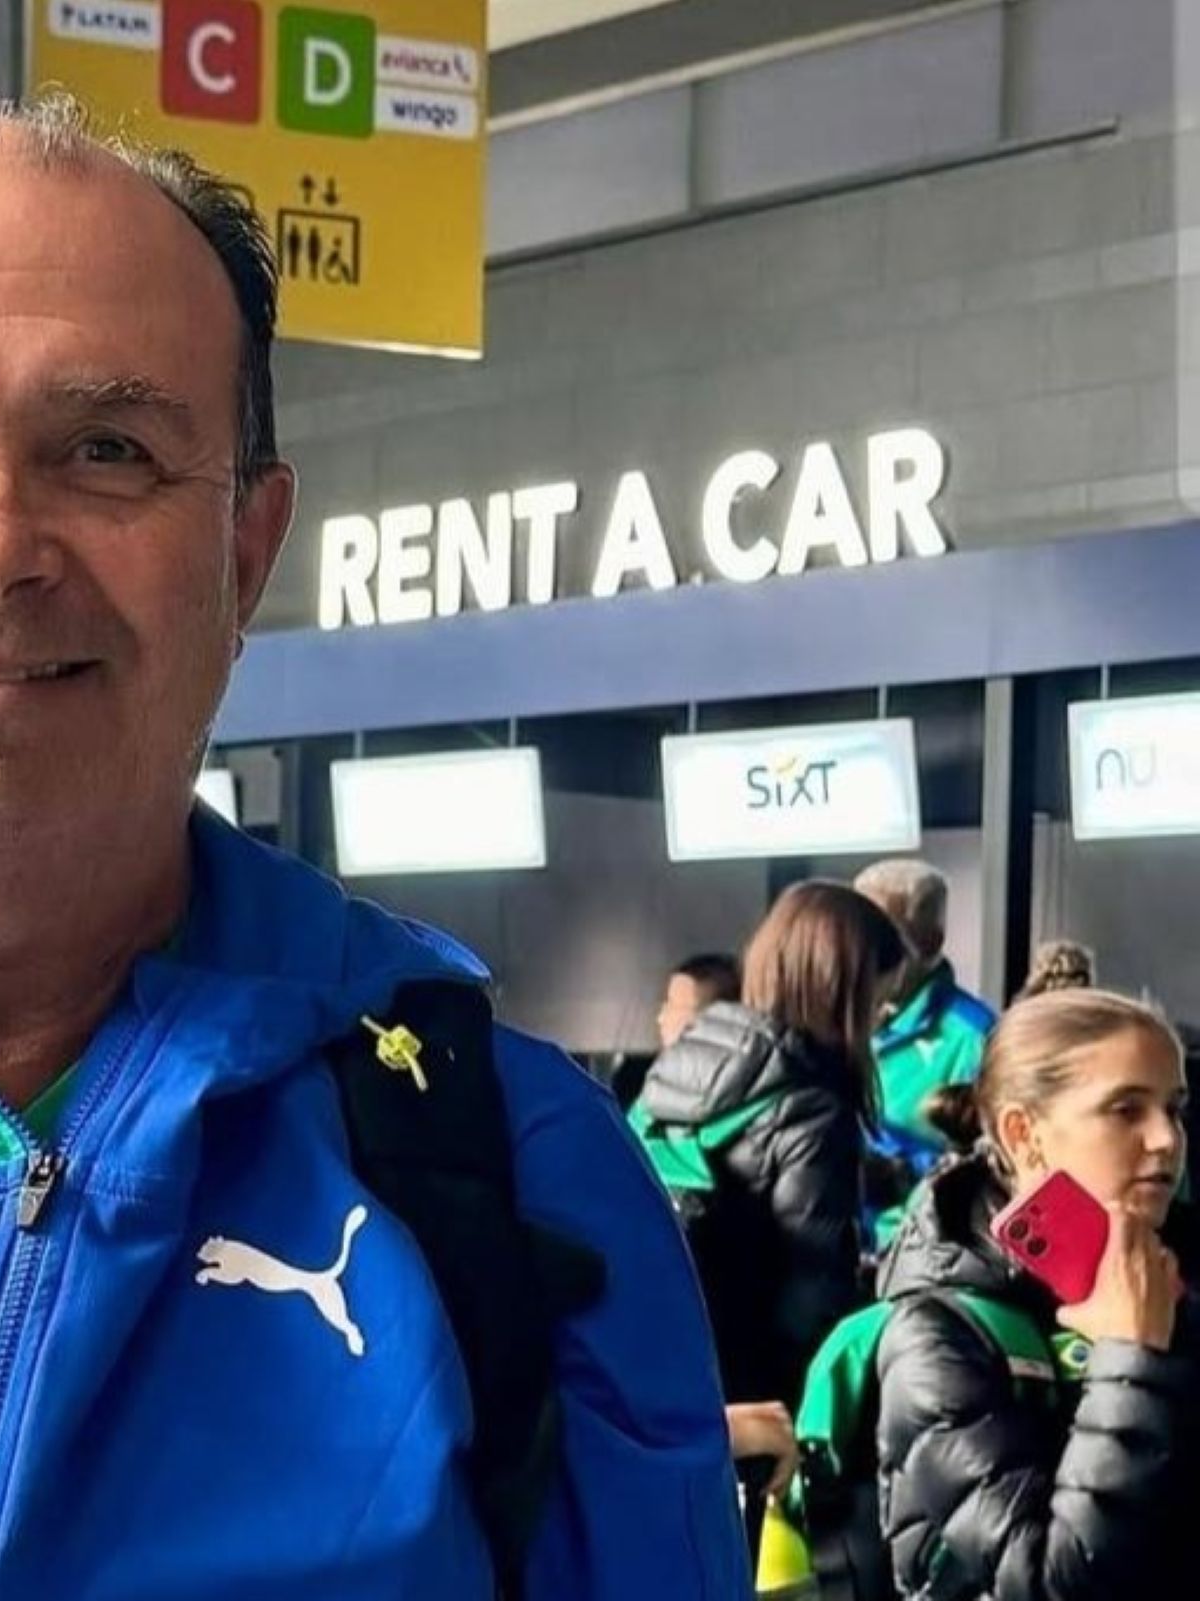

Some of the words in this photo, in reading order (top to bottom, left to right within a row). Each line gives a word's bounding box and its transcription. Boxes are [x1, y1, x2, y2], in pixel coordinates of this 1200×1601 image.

[187, 22, 236, 94] C
[304, 36, 352, 105] D
[389, 99, 457, 128] wingo
[318, 482, 578, 631] RENT
[590, 470, 677, 598] A
[701, 428, 947, 583] CAR
